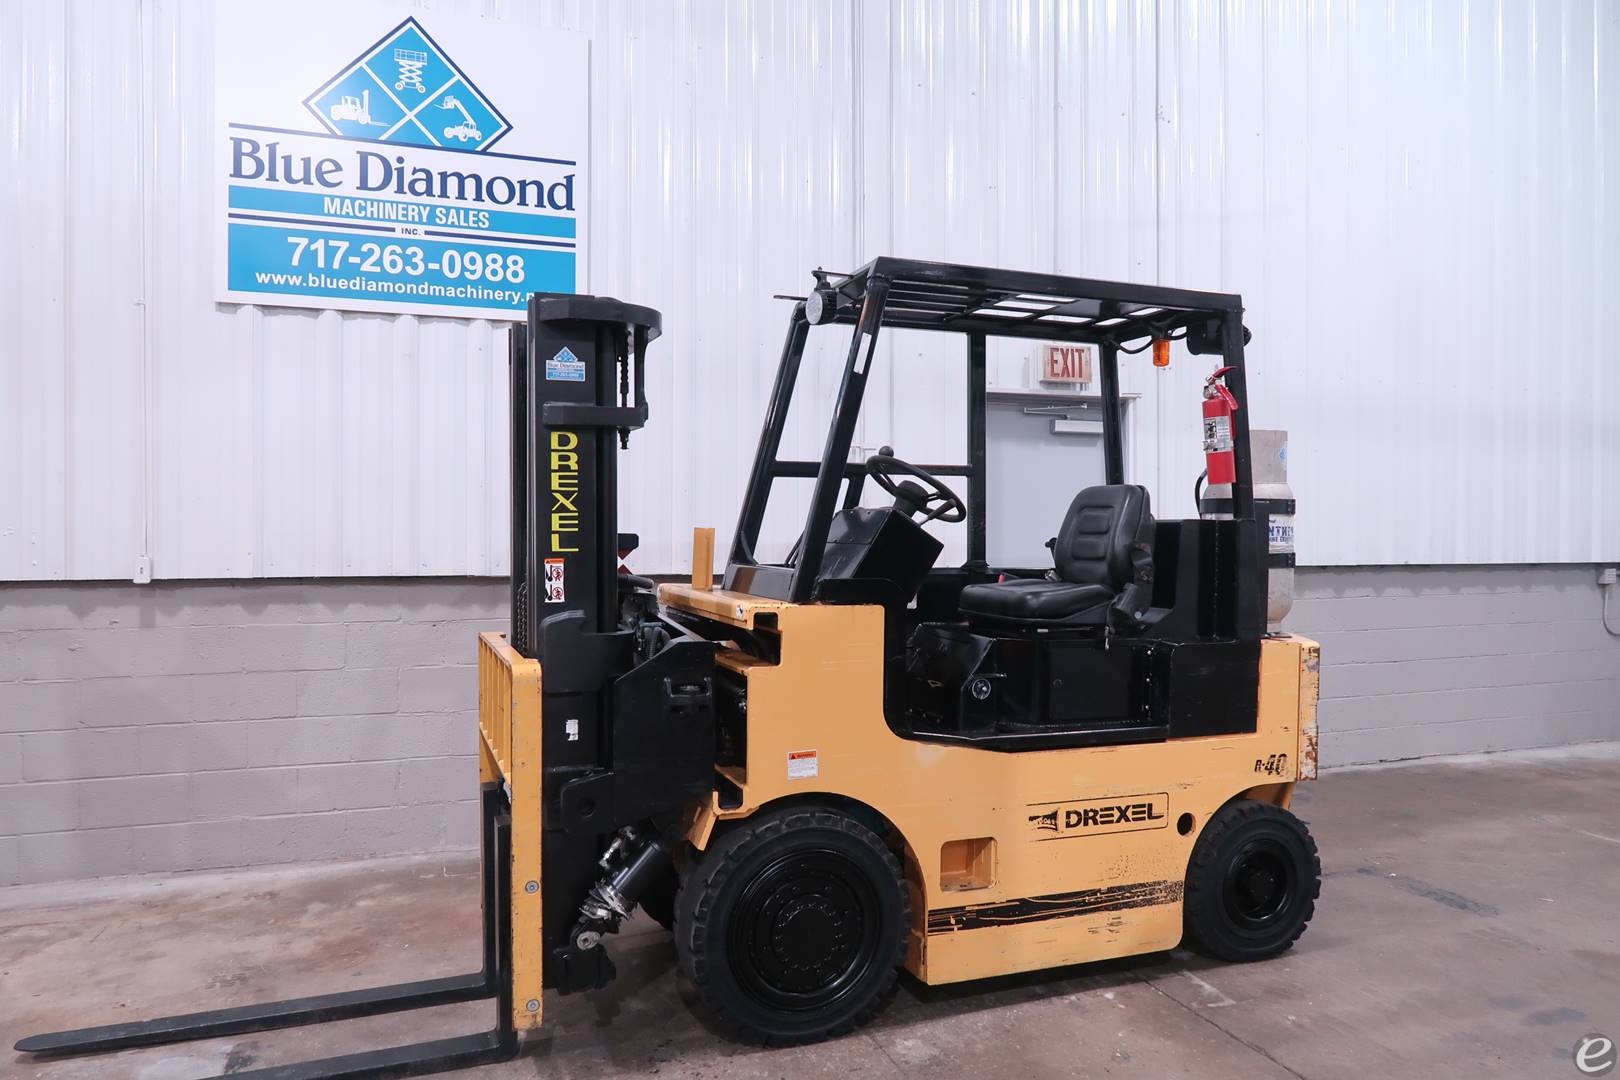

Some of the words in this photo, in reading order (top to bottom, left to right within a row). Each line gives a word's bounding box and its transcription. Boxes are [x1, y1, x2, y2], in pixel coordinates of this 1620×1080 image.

[229, 136, 344, 189] Blue
[356, 150, 575, 212] Diamond
[323, 196, 430, 224] MACHINERY
[435, 207, 490, 229] SALES
[400, 227, 422, 236] INC.
[287, 236, 526, 284] 717-263-0988
[255, 269, 535, 304] www.bluediamondmachinery.n
[1049, 347, 1085, 378] EXIT
[550, 431, 579, 552] DREXEL
[1065, 803, 1165, 829] DREXEL
